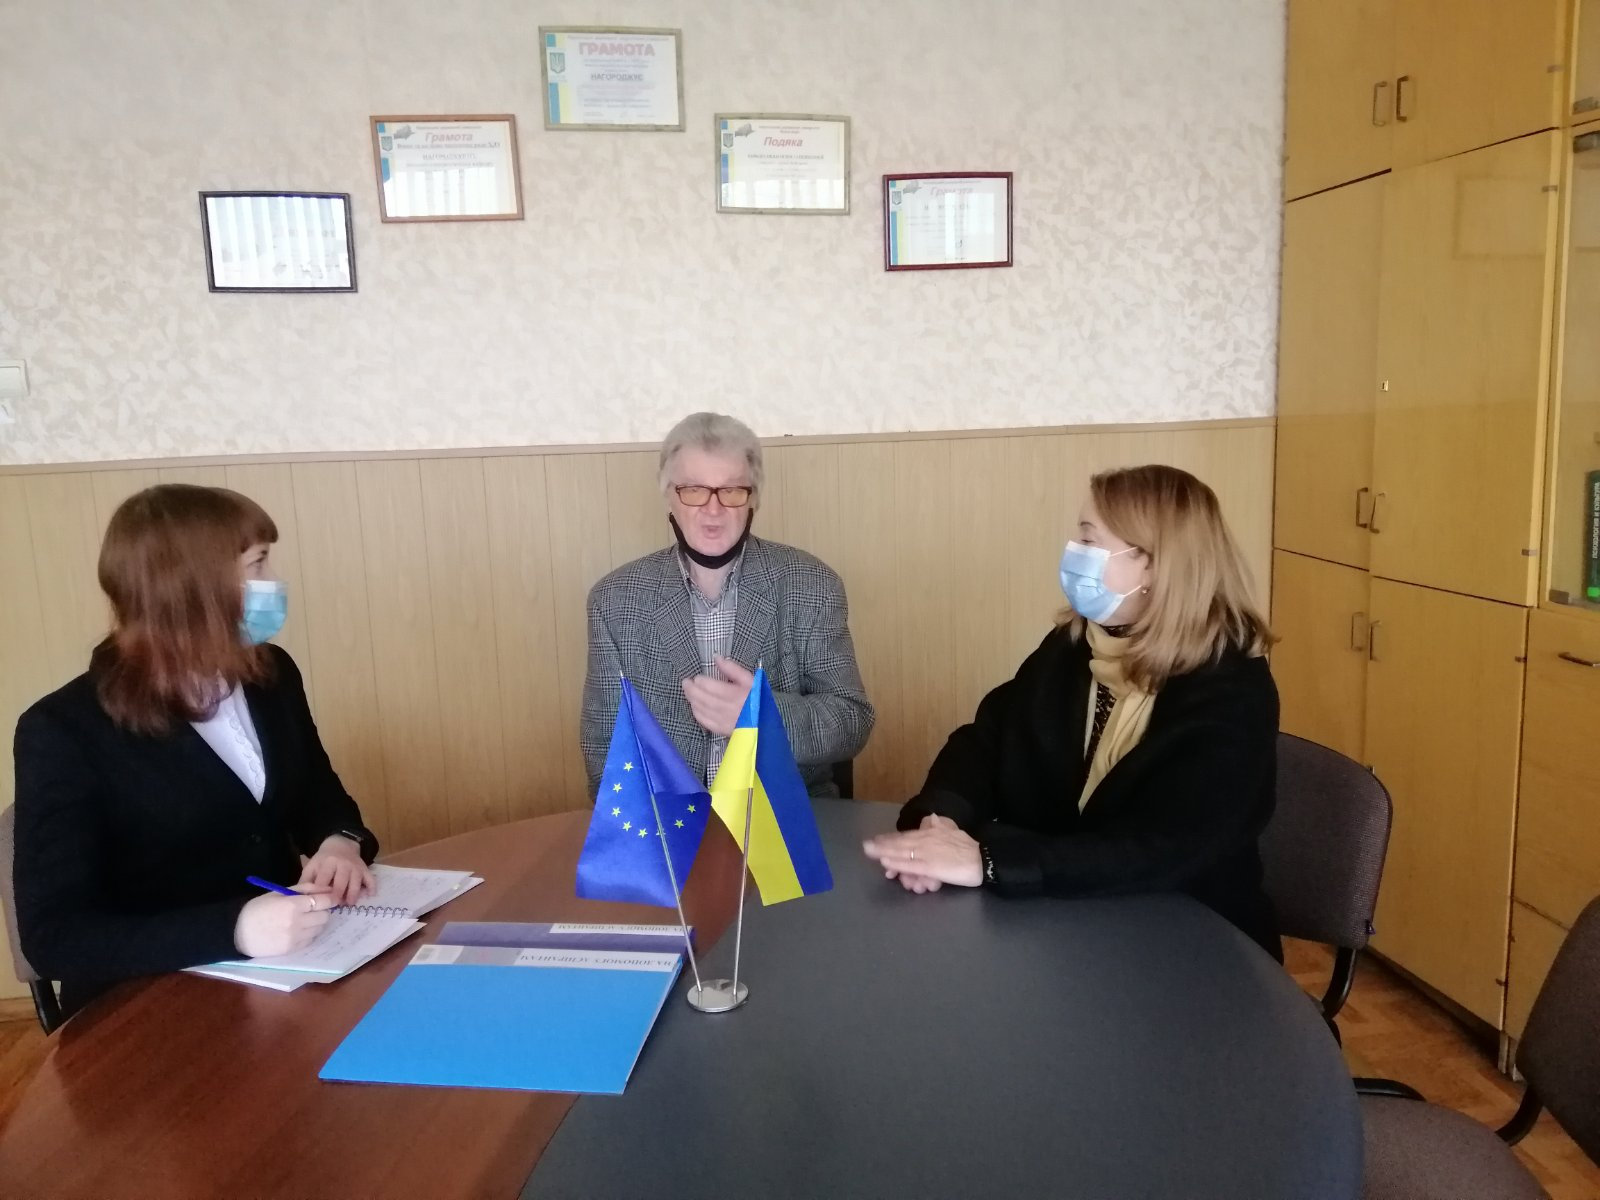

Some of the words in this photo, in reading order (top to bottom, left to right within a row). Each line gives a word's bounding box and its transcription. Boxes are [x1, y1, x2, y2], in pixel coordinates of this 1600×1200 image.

[579, 42, 655, 56] ГРАМОТА
[425, 132, 473, 143] Грамота
[763, 137, 803, 148] Подяка
